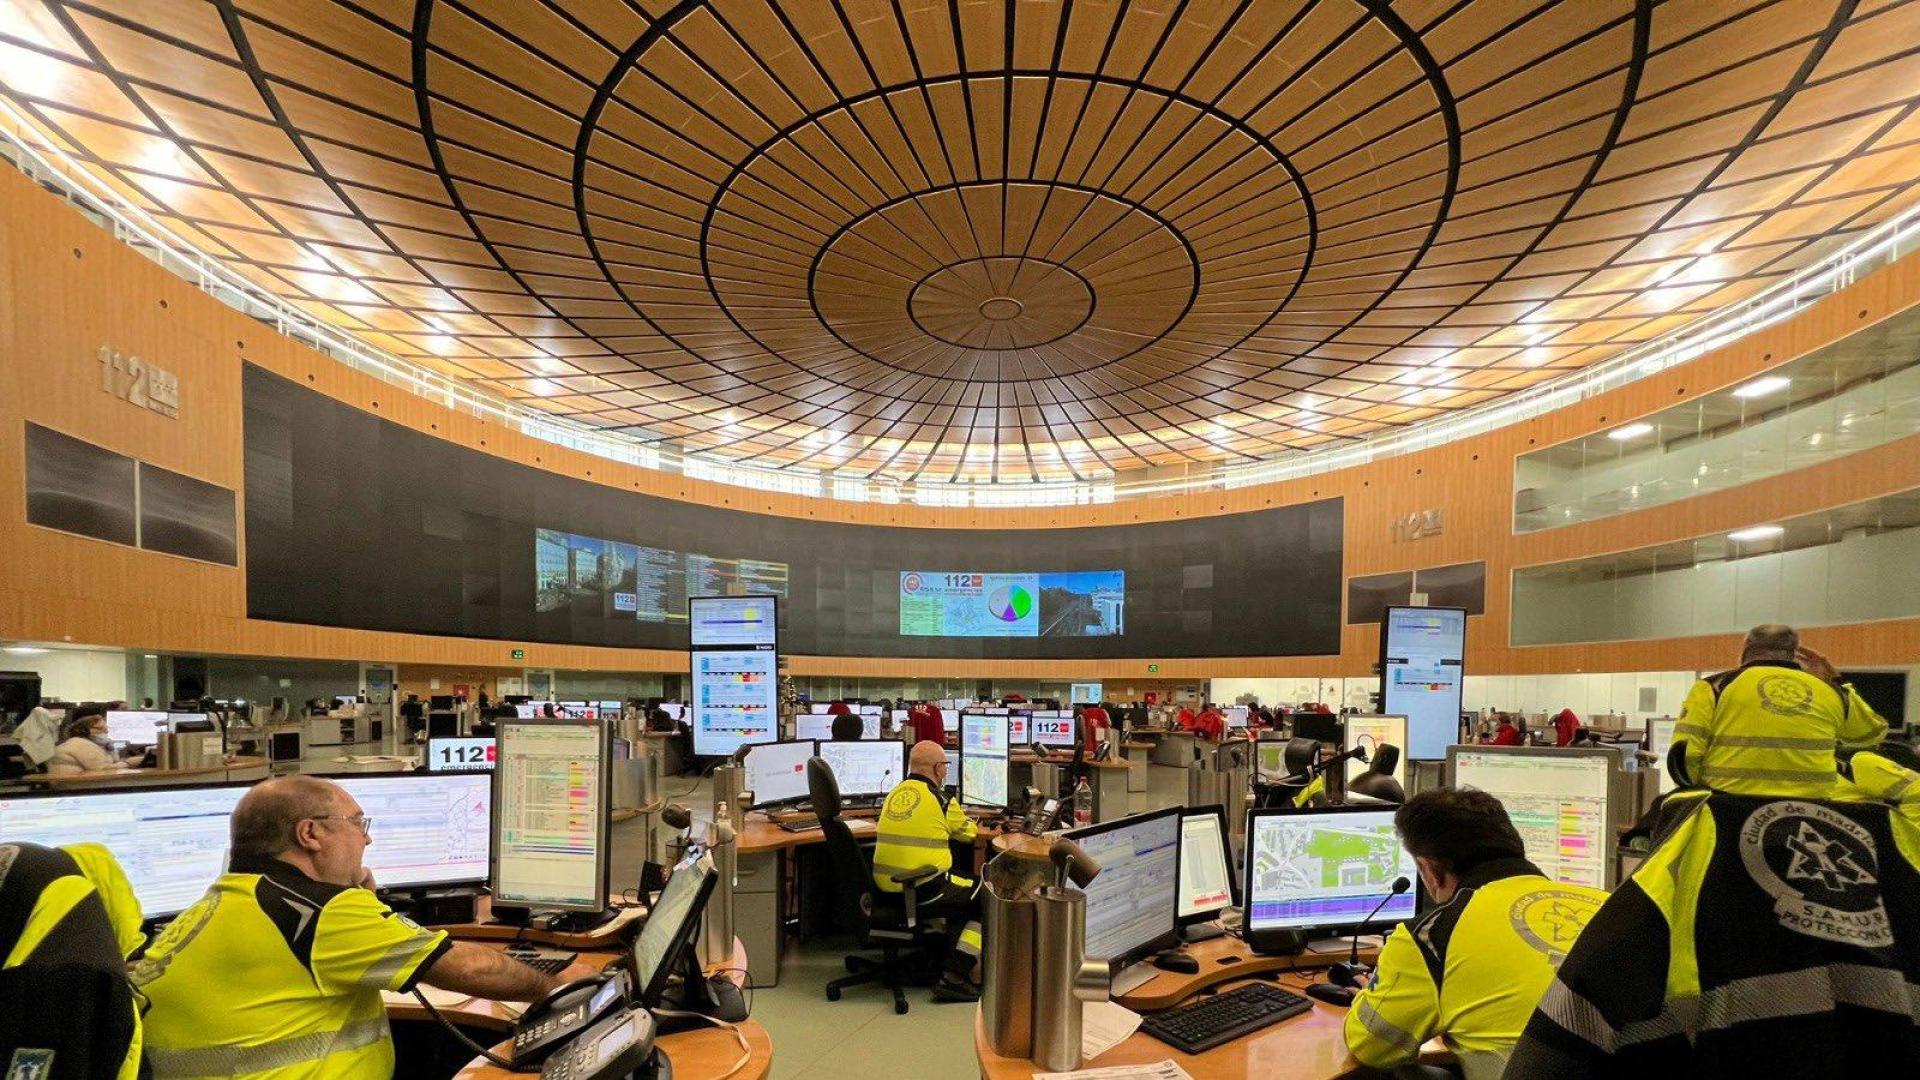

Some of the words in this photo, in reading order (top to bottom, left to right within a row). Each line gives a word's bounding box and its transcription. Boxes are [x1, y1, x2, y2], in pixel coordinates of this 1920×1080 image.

[945, 574, 970, 587] 112
[1037, 723, 1059, 733] 112
[440, 746, 484, 763] 112
[1744, 806, 1777, 844] ciudad
[1785, 803, 1806, 814] de
